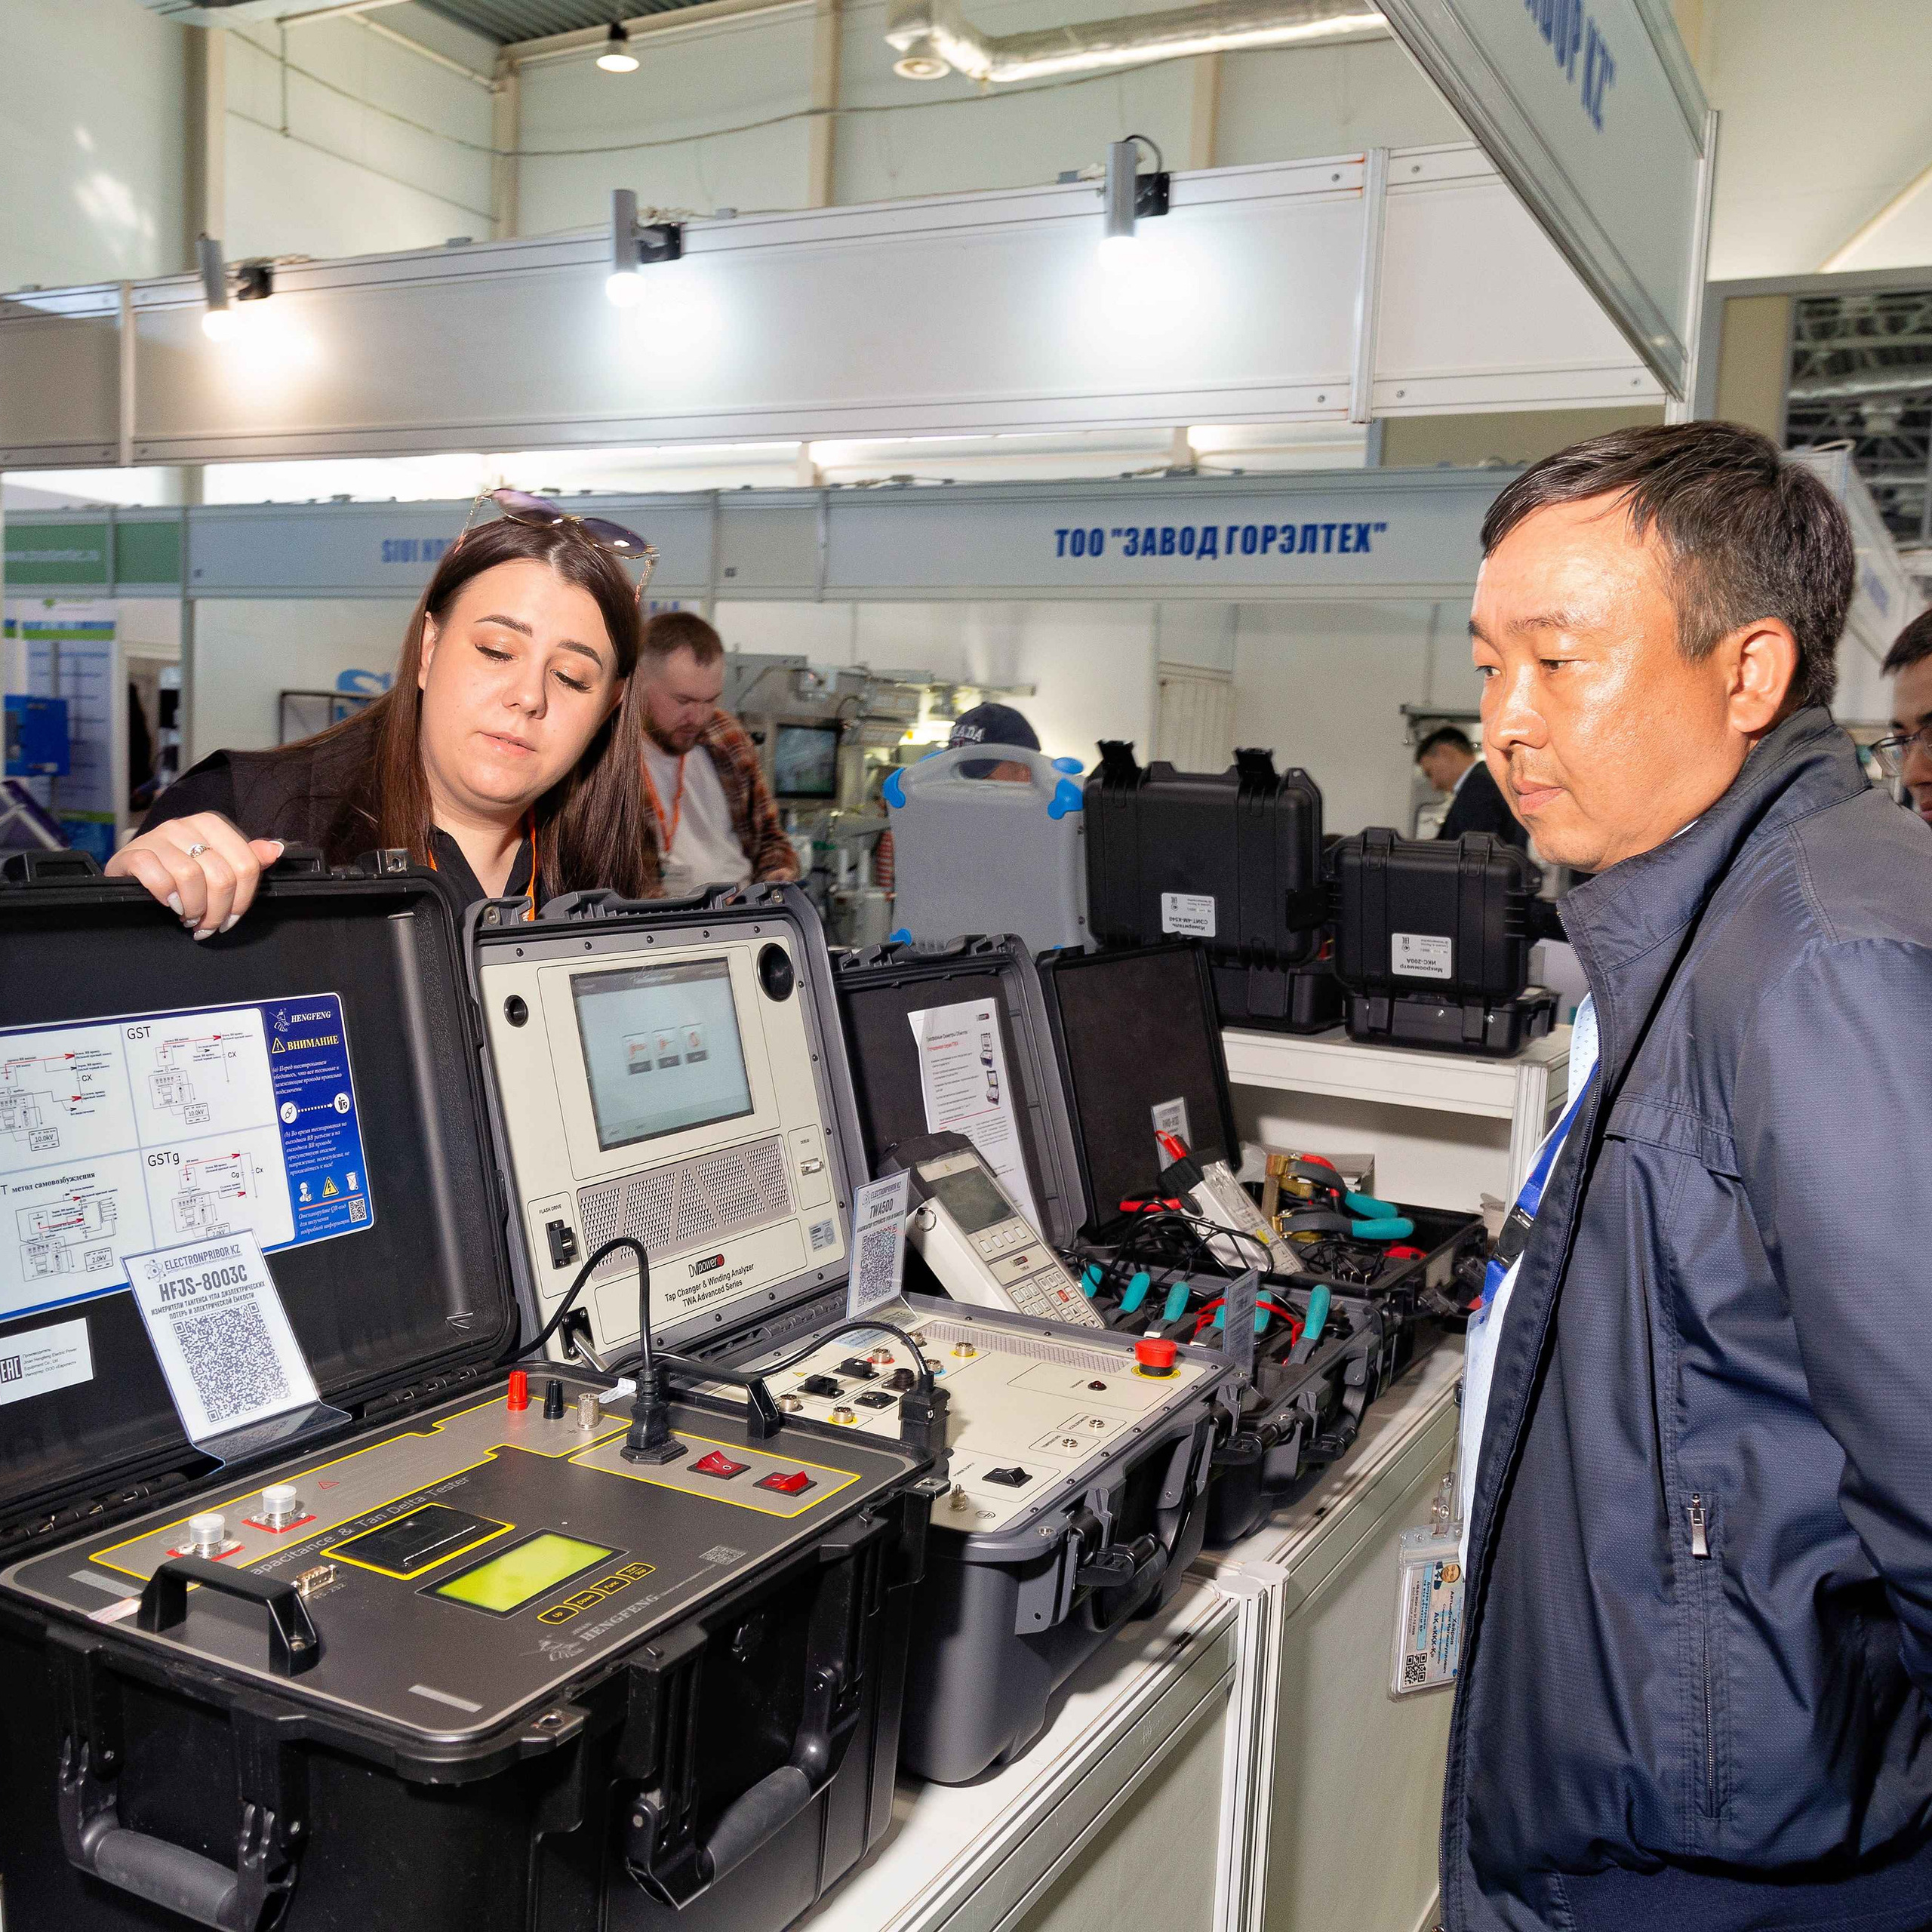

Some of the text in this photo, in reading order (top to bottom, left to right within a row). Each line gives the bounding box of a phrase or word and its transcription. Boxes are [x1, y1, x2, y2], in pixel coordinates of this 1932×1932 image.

[1055, 521, 1388, 560] ТОО "ЗАВОД ГОРЭЛТЕХ"
[1400, 964, 1443, 973] Микроомметр
[291, 1011, 331, 1023] HENGFENG
[127, 1026, 151, 1040] GST
[287, 1035, 340, 1051] ВНИМАНИЕ
[188, 1109, 205, 1117] 10.0kV
[35, 1134, 54, 1143] 10.0kV
[147, 1151, 180, 1167] GSTg
[11, 1184, 34, 1194] метод
[35, 1172, 96, 1190] самовозбуждения
[869, 1198, 894, 1219] TWA500
[91, 1254, 107, 1263] 2.0kV
[165, 1244, 242, 1271] ELECTRONPRIBOR KZ
[158, 1264, 248, 1303] HFJS-8003C
[665, 1263, 755, 1303] Tap Changer & Winding Analyzer
[151, 1281, 266, 1317] ИЗМЕРИТЕЛИ ТАНГЕНСА УГЛА ДИЭЛЕКТРИЧЕСКИХ
[682, 1279, 743, 1308] TWA Advanced Series
[169, 1309, 189, 1320] ПОТЕРЬ
[193, 1297, 233, 1314] ЭЛЕКТРИЧЕСКОЙ
[251, 1475, 472, 1577] apacitance & Tan Delta Tester
[635, 1568, 648, 1577] Stop
[313, 1582, 347, 1601] RS-232
[604, 1579, 620, 1590] Func
[577, 1594, 595, 1606] Down
[552, 1611, 564, 1620] Up
[579, 1593, 660, 1642] HENGFENG
